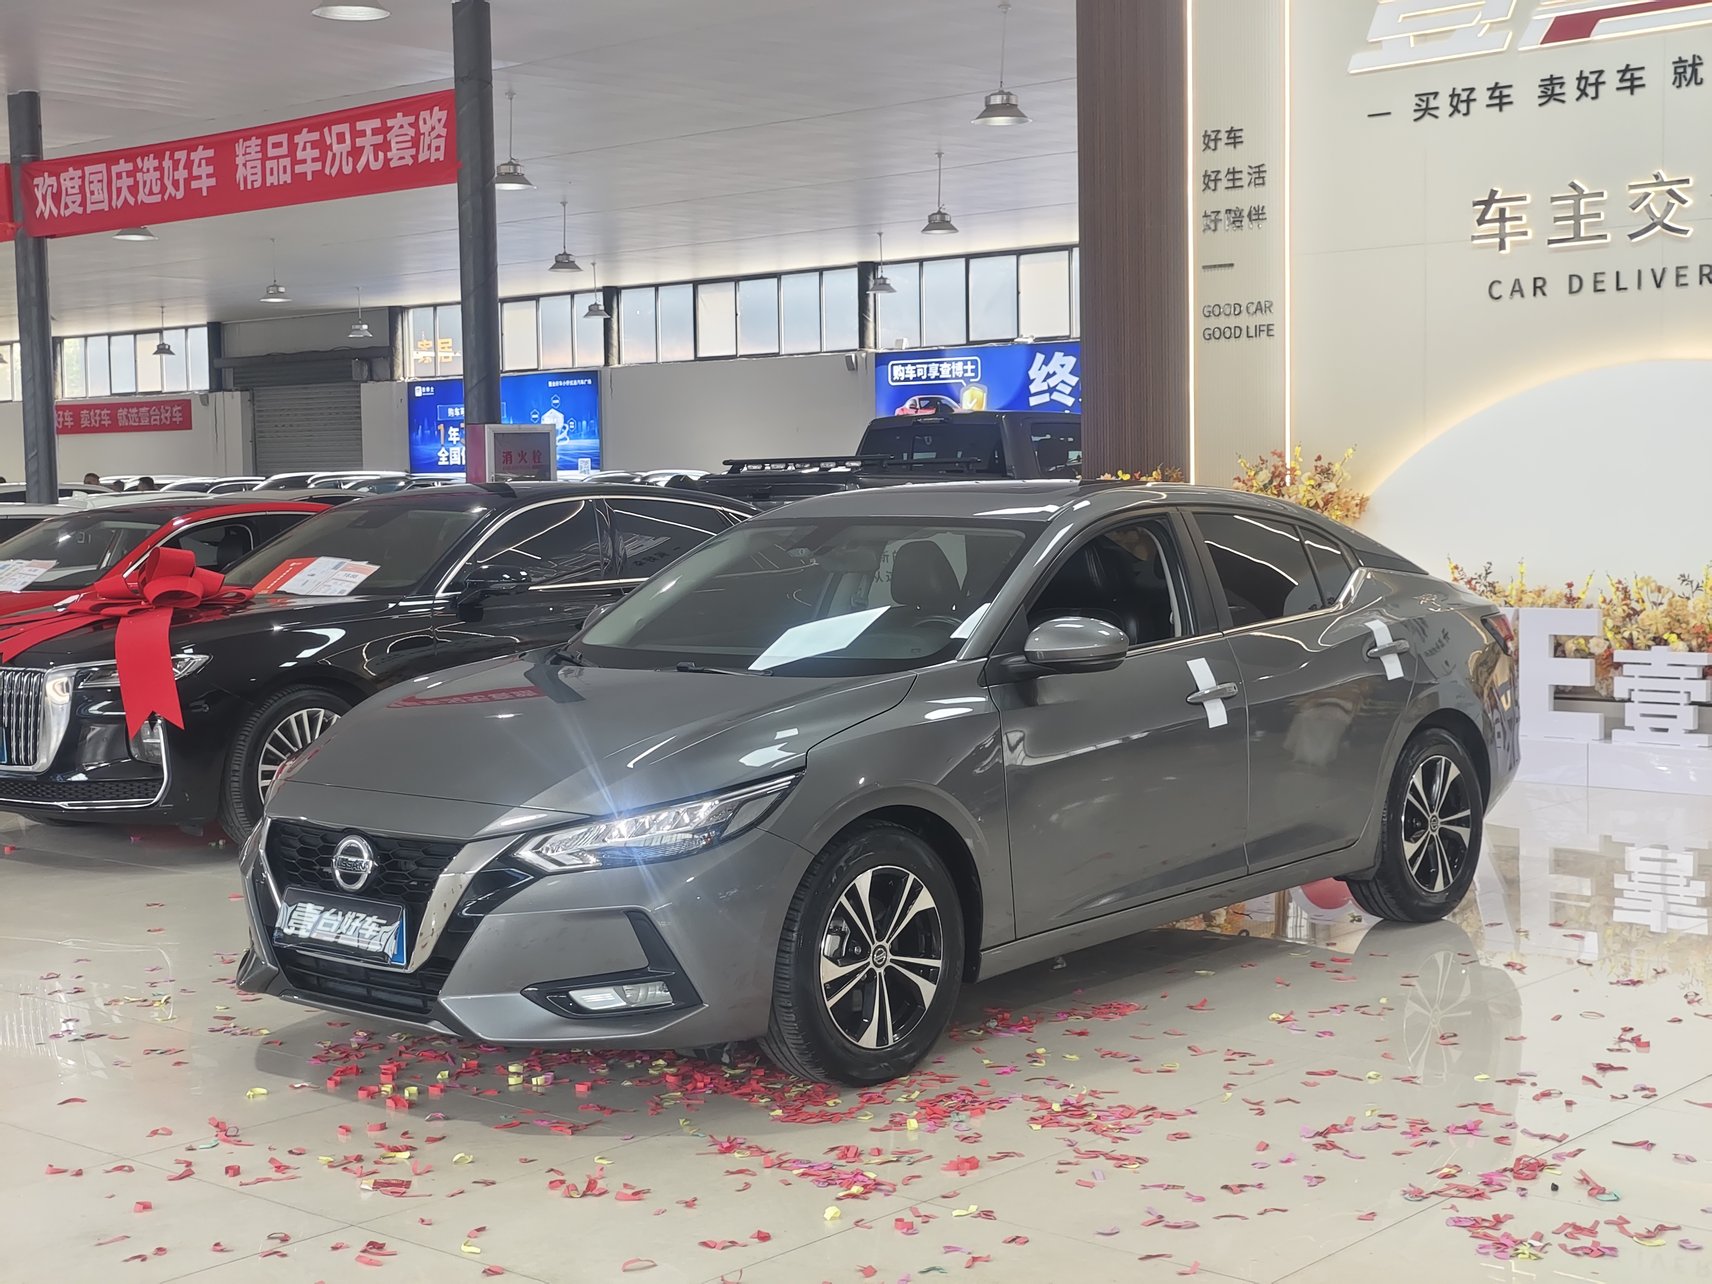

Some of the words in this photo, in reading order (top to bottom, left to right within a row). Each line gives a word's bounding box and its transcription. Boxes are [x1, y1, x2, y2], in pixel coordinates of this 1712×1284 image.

[1412, 81, 1514, 122] 买好车
[1537, 63, 1647, 108] 卖好车
[1670, 54, 1705, 89] 就
[1202, 126, 1245, 152] 好车
[32, 145, 217, 221] 欢度国庆选好车
[234, 106, 449, 191] 精品车况无套路
[1202, 163, 1268, 193] 好生活
[1202, 204, 1268, 233] 好陪伴
[1470, 169, 1693, 253] 车主交
[1488, 276, 1547, 300] CAR
[1568, 263, 1712, 295] DELIVER
[1202, 302, 1243, 318] GOOD
[1246, 300, 1274, 315] CAR
[1202, 325, 1243, 341] GOOD
[1246, 323, 1275, 339] LIFE
[892, 362, 976, 381] 购车可享查博士
[1027, 351, 1080, 407] 终
[80, 408, 112, 428] 卖好车
[117, 405, 183, 427] 就选壹台好车
[502, 449, 543, 465] 消火栓
